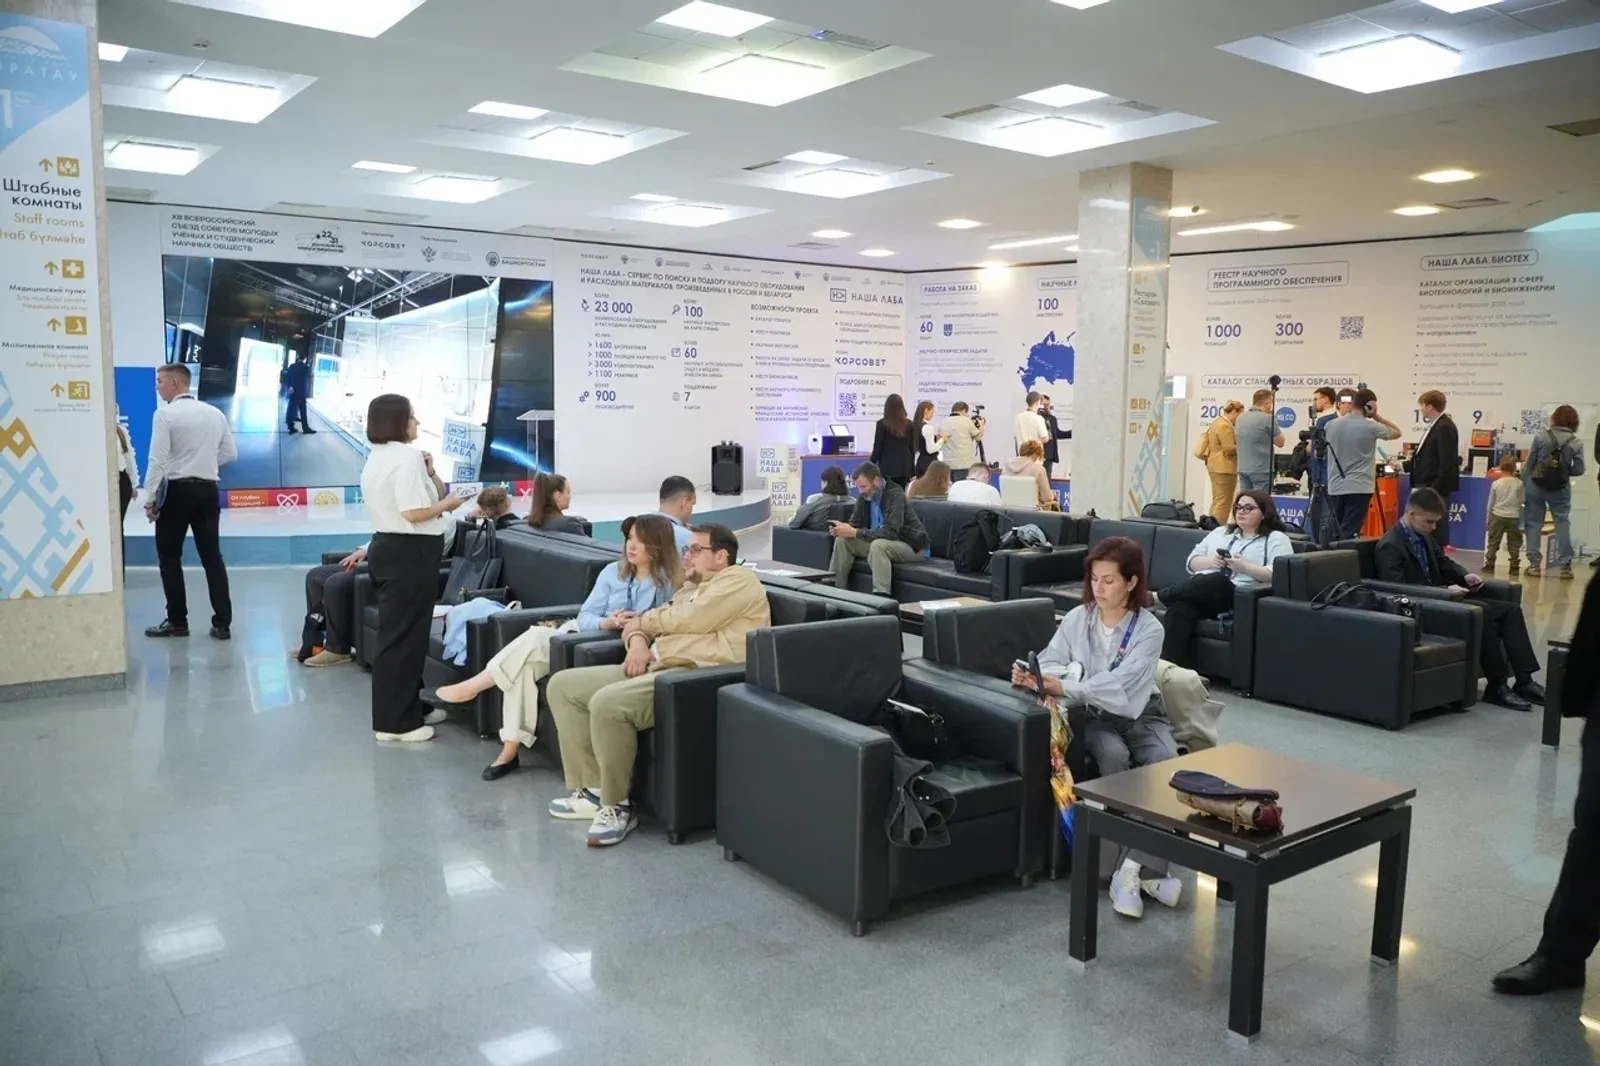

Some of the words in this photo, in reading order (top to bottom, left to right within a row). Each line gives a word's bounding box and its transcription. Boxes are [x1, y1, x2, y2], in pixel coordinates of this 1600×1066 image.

[3, 178, 81, 198] Штабные
[12, 196, 82, 210] комнаты
[14, 212, 43, 225] Staff
[47, 216, 85, 228] rooms
[184, 214, 255, 226] ВСЕРОССИЙСКИЙ
[172, 223, 200, 231] СЪЕЗД
[200, 224, 238, 234] СОВЕТОВ
[239, 228, 279, 237] МОЛОДЫХ
[172, 240, 211, 248] НАУЧНЫХ
[213, 243, 252, 252] ОБЩЕСТВ
[214, 235, 275, 245] СТУДЕНЧЕСКИХ
[1427, 257, 1458, 268] НАША
[1213, 271, 1240, 279] РЕЕСТР
[1242, 267, 1287, 277] НАУЧНОГО
[580, 268, 601, 276] НАША
[603, 269, 621, 277] ЛАБА
[627, 271, 652, 279] СЕРВИС
[665, 274, 690, 283] ПОИСКУ
[698, 277, 726, 285] ПОДБОРУ
[727, 279, 759, 288] НАУЧНОГО
[760, 281, 805, 291] ОБОРУДОВАНИЯ
[1041, 280, 1073, 288] НАУЧНЫЕ
[1213, 278, 1280, 289] ПРОГРАММНОГО
[1282, 275, 1342, 286] ОБЕСПЕЧЕНИЯ
[1420, 279, 1453, 288] КАТАЛОГ
[1454, 277, 1510, 287] ОРГАНИЗАЦИЙ
[1519, 275, 1544, 283] СФЕРЕ
[587, 278, 630, 287] РАСХОДНЫХ
[733, 288, 757, 296] РОССИИ
[764, 290, 793, 299] БЕЛАРУСИ
[924, 285, 946, 293] РАБОТА
[1419, 287, 1482, 297] БИОТЕХНОЛОГИЙ
[1491, 285, 1555, 294] БИОИНЖЕНЕРИИ
[851, 292, 878, 303] НАША
[881, 293, 904, 305] ЛАБА
[1037, 297, 1059, 310] 100
[685, 306, 703, 318] 100
[920, 321, 934, 333] 60
[1275, 322, 1304, 336] 300
[684, 347, 697, 359] 60
[835, 357, 886, 367] КОРСОВЕТ
[1207, 377, 1244, 386] КАТАЛОГ
[1307, 377, 1354, 386] ОБРАЗЦОВ
[595, 390, 616, 402] 900
[684, 391, 691, 402] 7
[447, 437, 477, 451] НАША
[445, 445, 471, 458] ЛАБА
[760, 459, 784, 467] НАША
